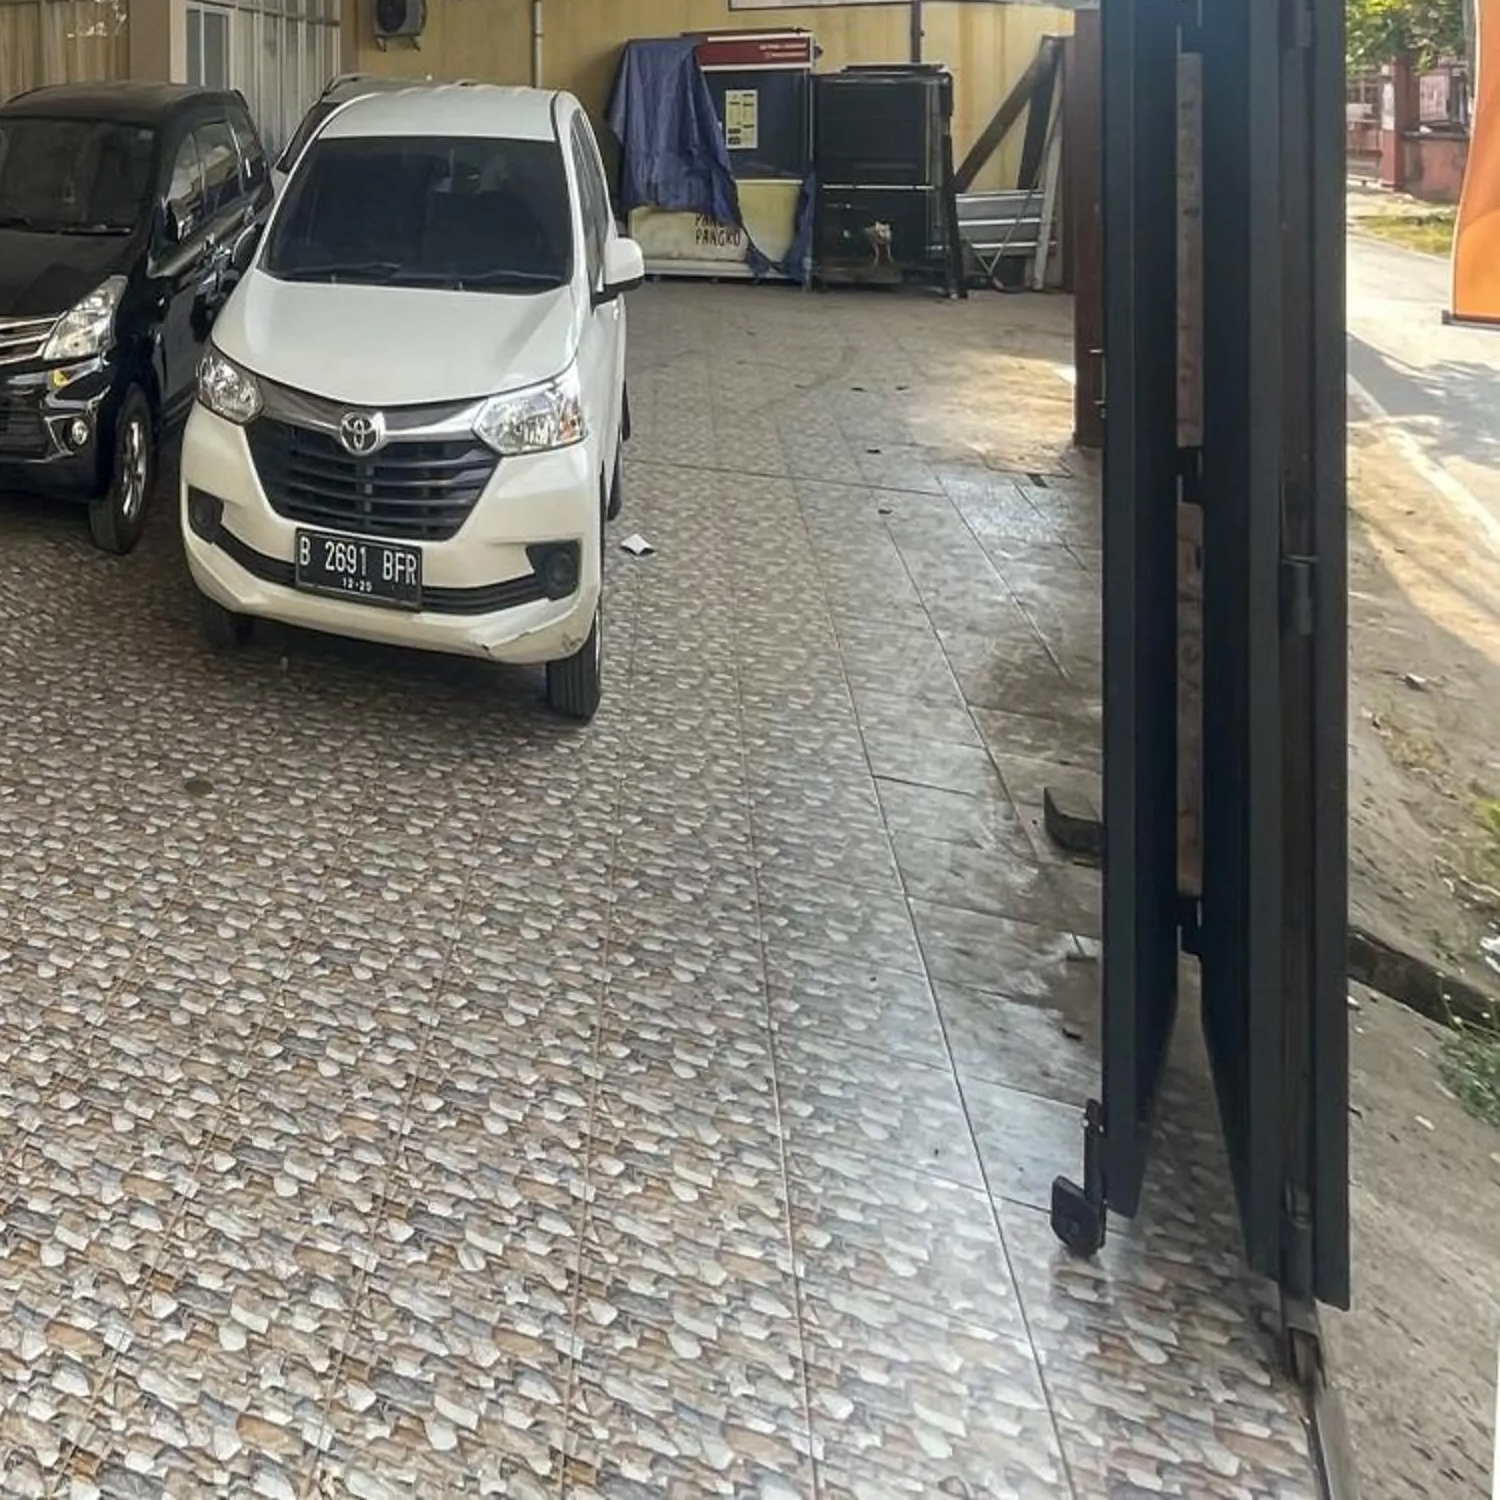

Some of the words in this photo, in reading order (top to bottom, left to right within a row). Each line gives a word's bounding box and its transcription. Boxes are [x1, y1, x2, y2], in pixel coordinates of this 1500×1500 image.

[300, 536, 311, 565] B
[325, 541, 367, 576] 2691
[383, 550, 417, 585] BFR
